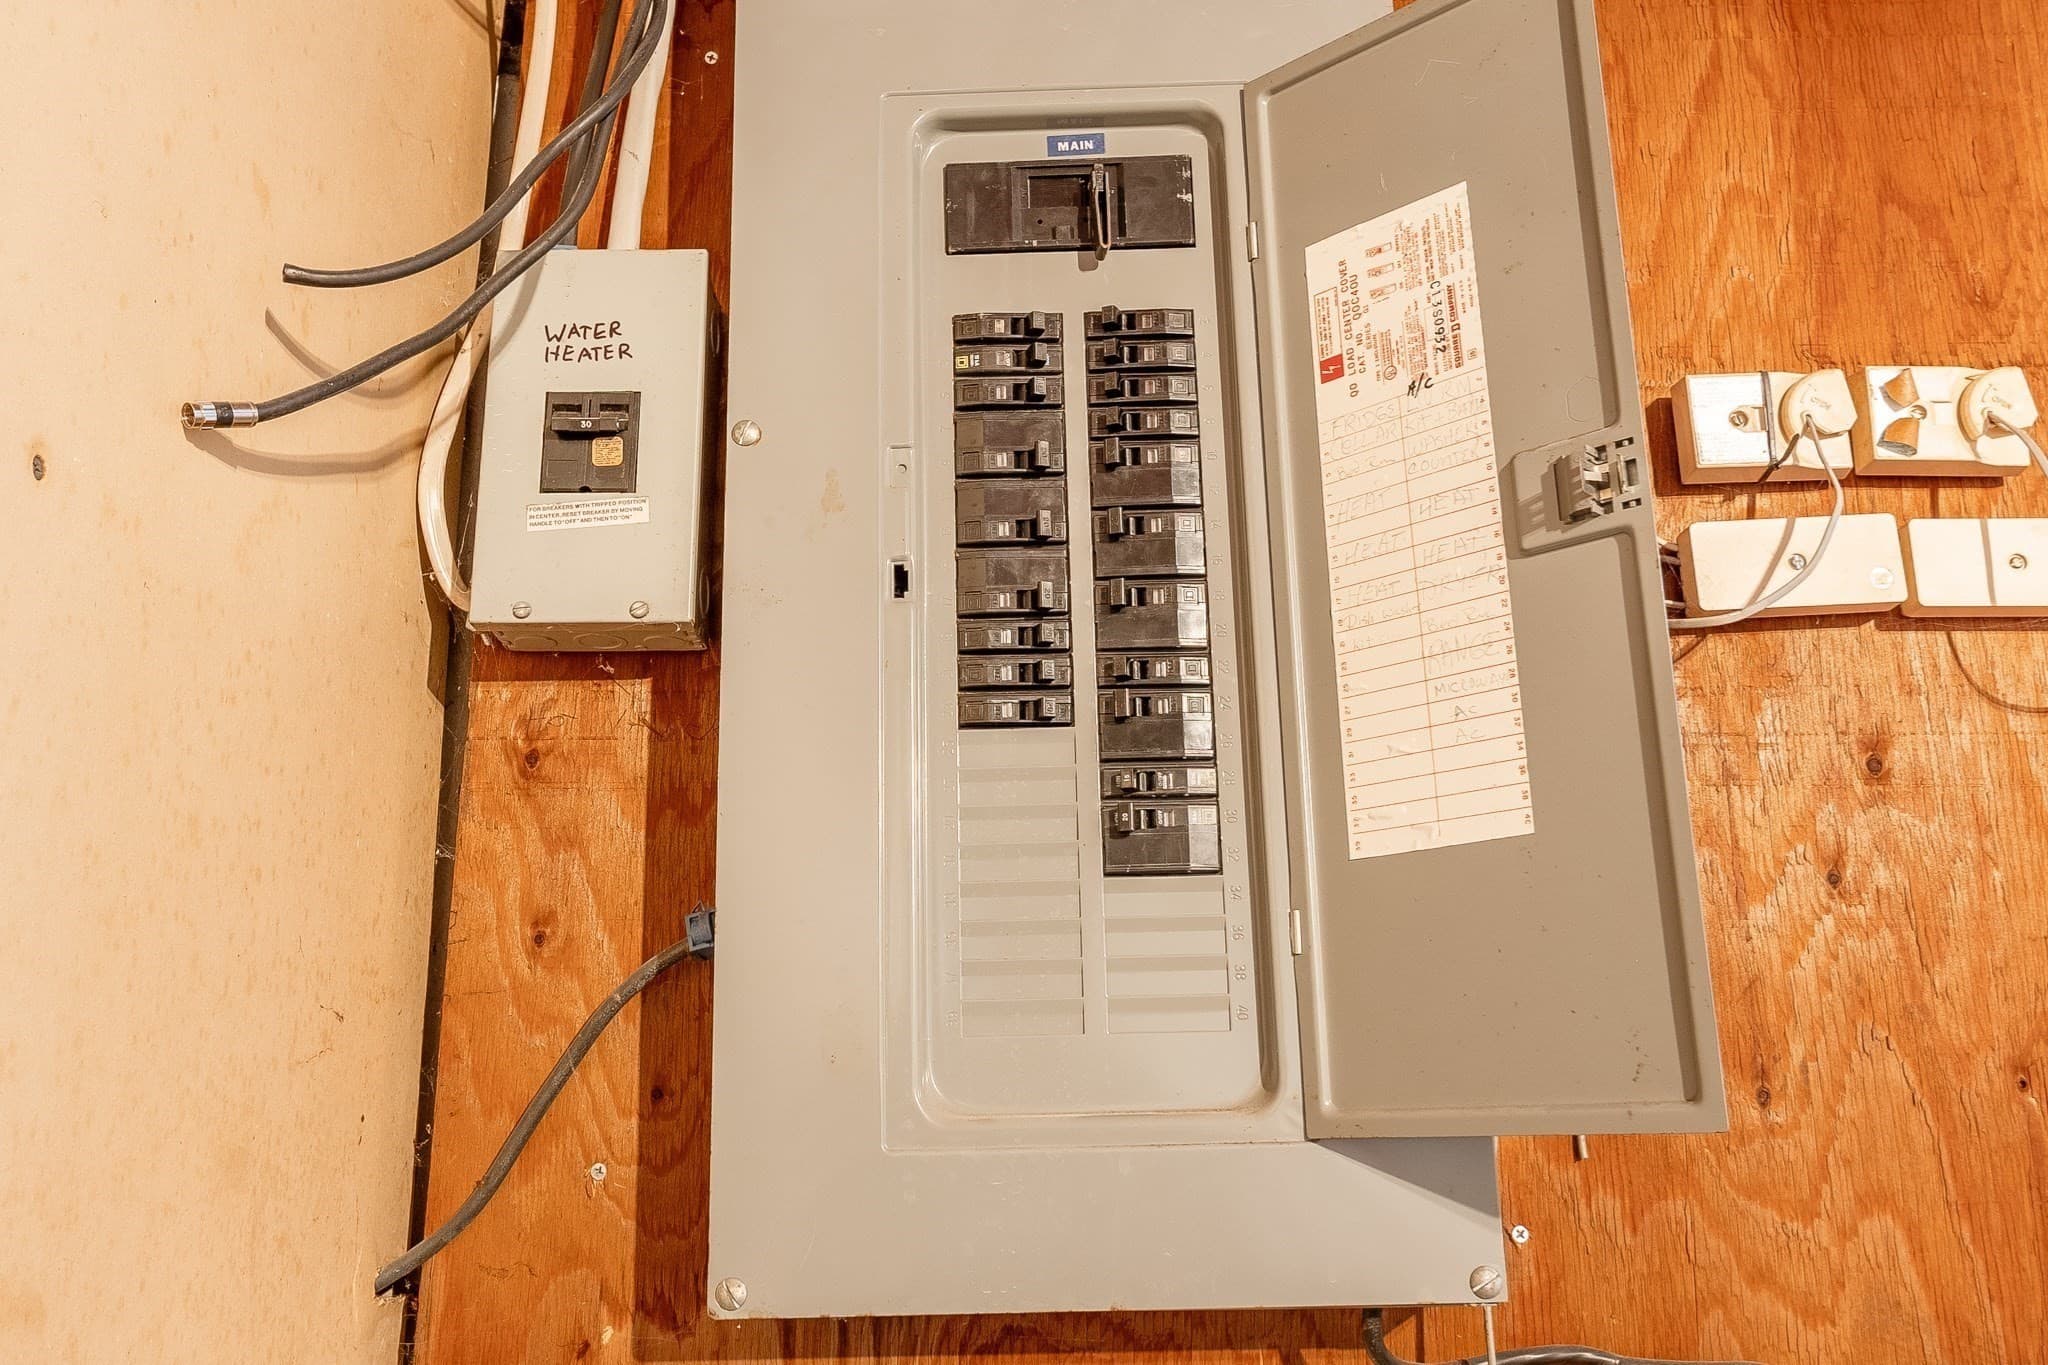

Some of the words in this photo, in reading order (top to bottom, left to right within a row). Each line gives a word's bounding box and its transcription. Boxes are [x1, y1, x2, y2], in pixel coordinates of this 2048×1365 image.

[1057, 139, 1094, 152] MAIN
[1338, 258, 1349, 293] COVER
[1446, 285, 1456, 323] COMPANY
[1341, 299, 1353, 340] CENTER
[544, 320, 623, 343] WATER
[544, 342, 634, 363] HEATER
[1452, 334, 1461, 368] SQUARE
[1346, 347, 1357, 377] LOAD
[1407, 373, 1434, 398] A/C
[580, 420, 593, 428] 30
[542, 504, 574, 512] BREAKERS
[1337, 487, 1391, 529] HEAT
[1419, 488, 1479, 516] HEAT
[1345, 531, 1406, 564] HEAT
[1423, 536, 1487, 563] HEAT
[1349, 580, 1400, 605] HEAT
[1215, 624, 1227, 638] 20
[1217, 660, 1229, 674] 22
[1218, 695, 1231, 711] 24
[1221, 733, 1233, 748] 26
[1223, 770, 1236, 786] 28
[1225, 809, 1237, 824] 30
[1227, 847, 1240, 862] 32
[1230, 885, 1241, 901] 34
[1232, 925, 1245, 940] 36
[1234, 964, 1246, 980] 38
[1236, 1005, 1248, 1020] 40
